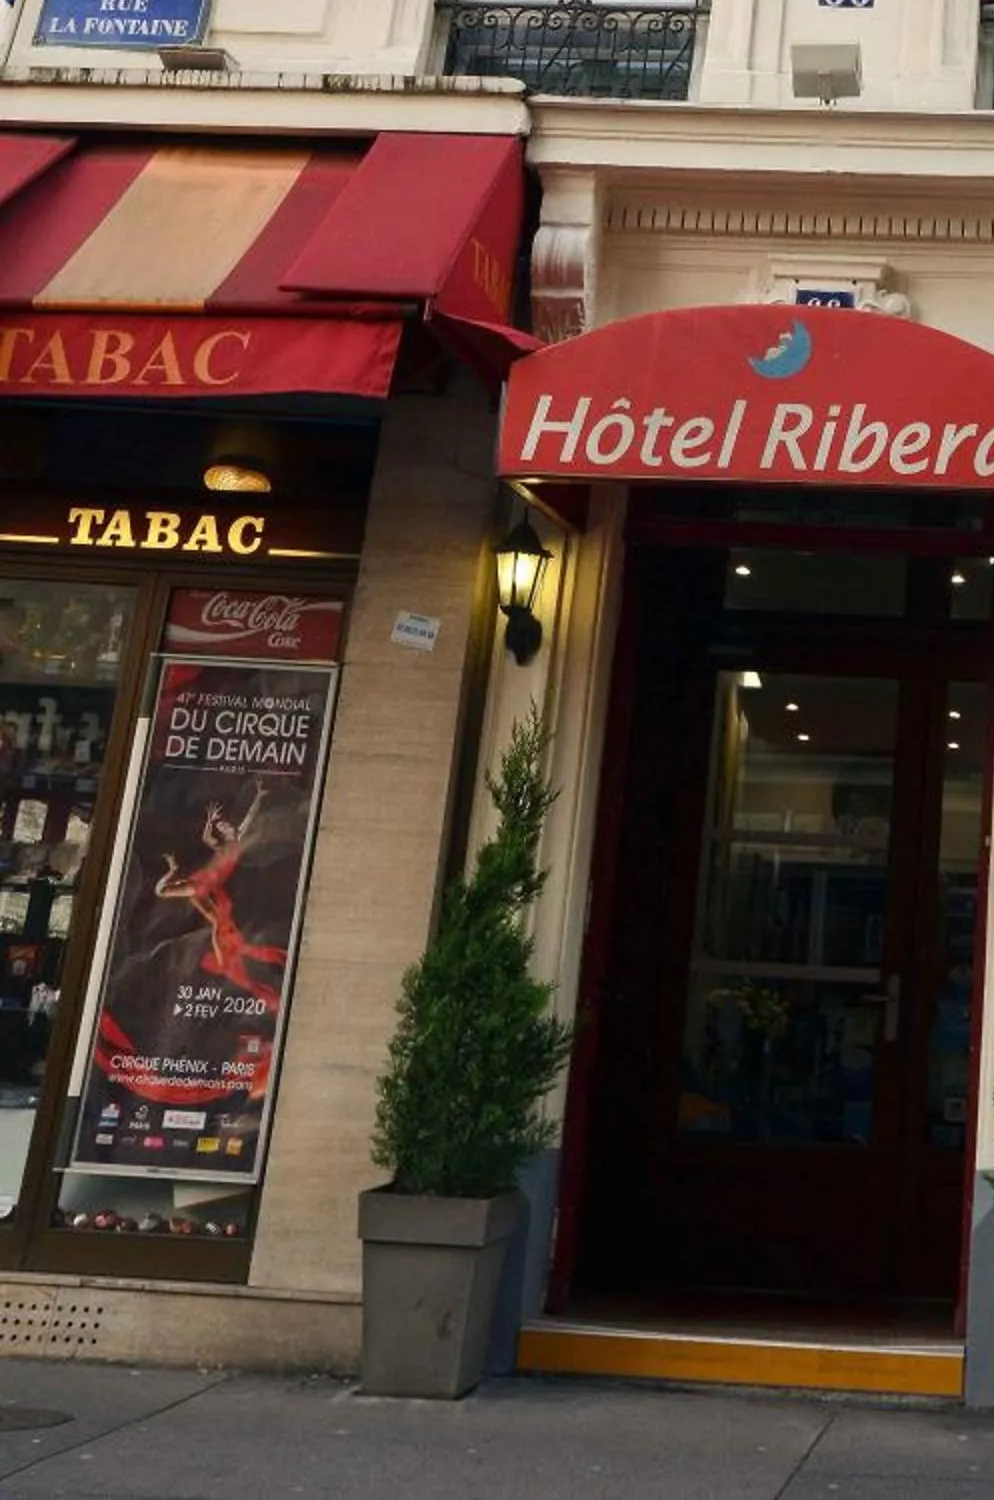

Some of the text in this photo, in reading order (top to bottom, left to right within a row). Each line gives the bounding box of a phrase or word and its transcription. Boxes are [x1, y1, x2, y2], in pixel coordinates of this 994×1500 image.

[49, 17, 189, 37] LA FONTAINE
[0, 328, 251, 385] TABAC
[520, 394, 748, 470] Hôtel
[68, 507, 265, 555] TABAC
[198, 693, 247, 709] FESTIVAL
[251, 697, 311, 711] MONDIAL
[170, 707, 310, 739] DU CIRQUE
[165, 735, 307, 766] DE DEMAIN
[177, 985, 222, 1001] 30 JAN
[185, 1004, 193, 1017] 2
[223, 996, 267, 1015] 2020
[111, 1055, 161, 1072] CIRQUE
[221, 1061, 256, 1077] PARIS
